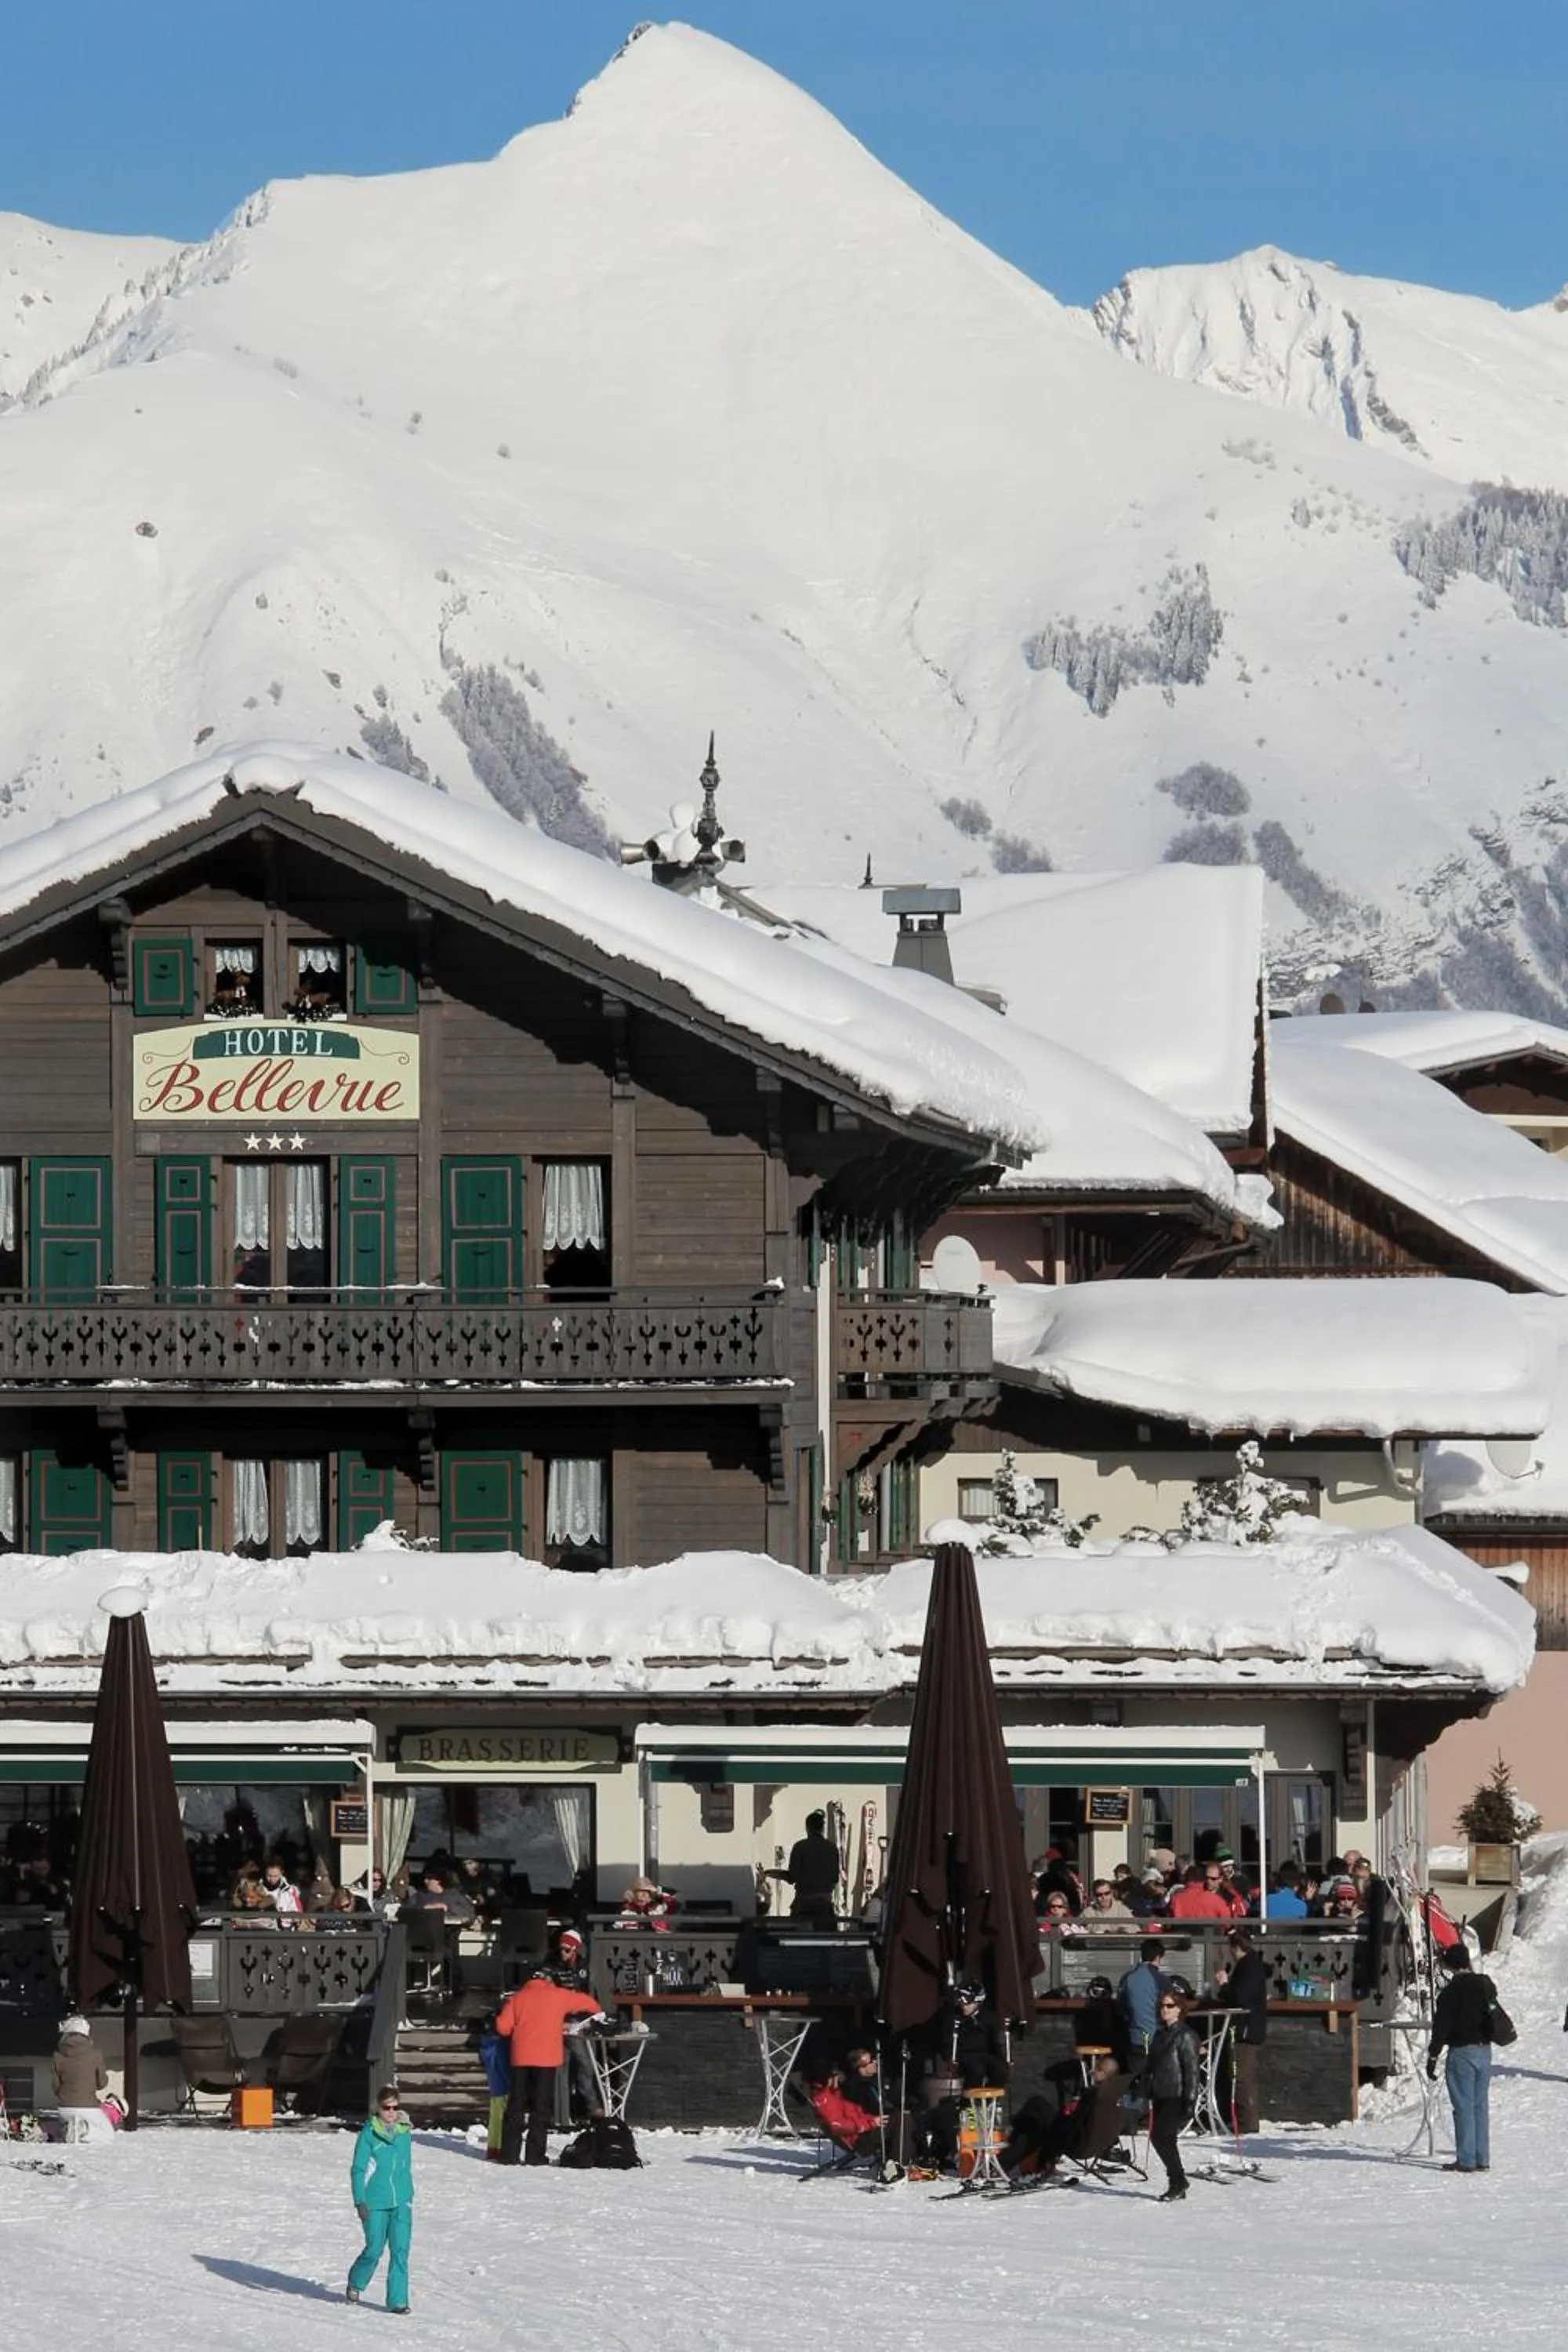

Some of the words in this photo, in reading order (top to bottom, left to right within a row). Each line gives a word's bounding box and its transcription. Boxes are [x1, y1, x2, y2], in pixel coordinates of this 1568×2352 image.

[223, 1029, 333, 1056] HOTEL
[138, 1058, 405, 1113] Bellevue
[419, 1737, 590, 1762] BRASSERIE
